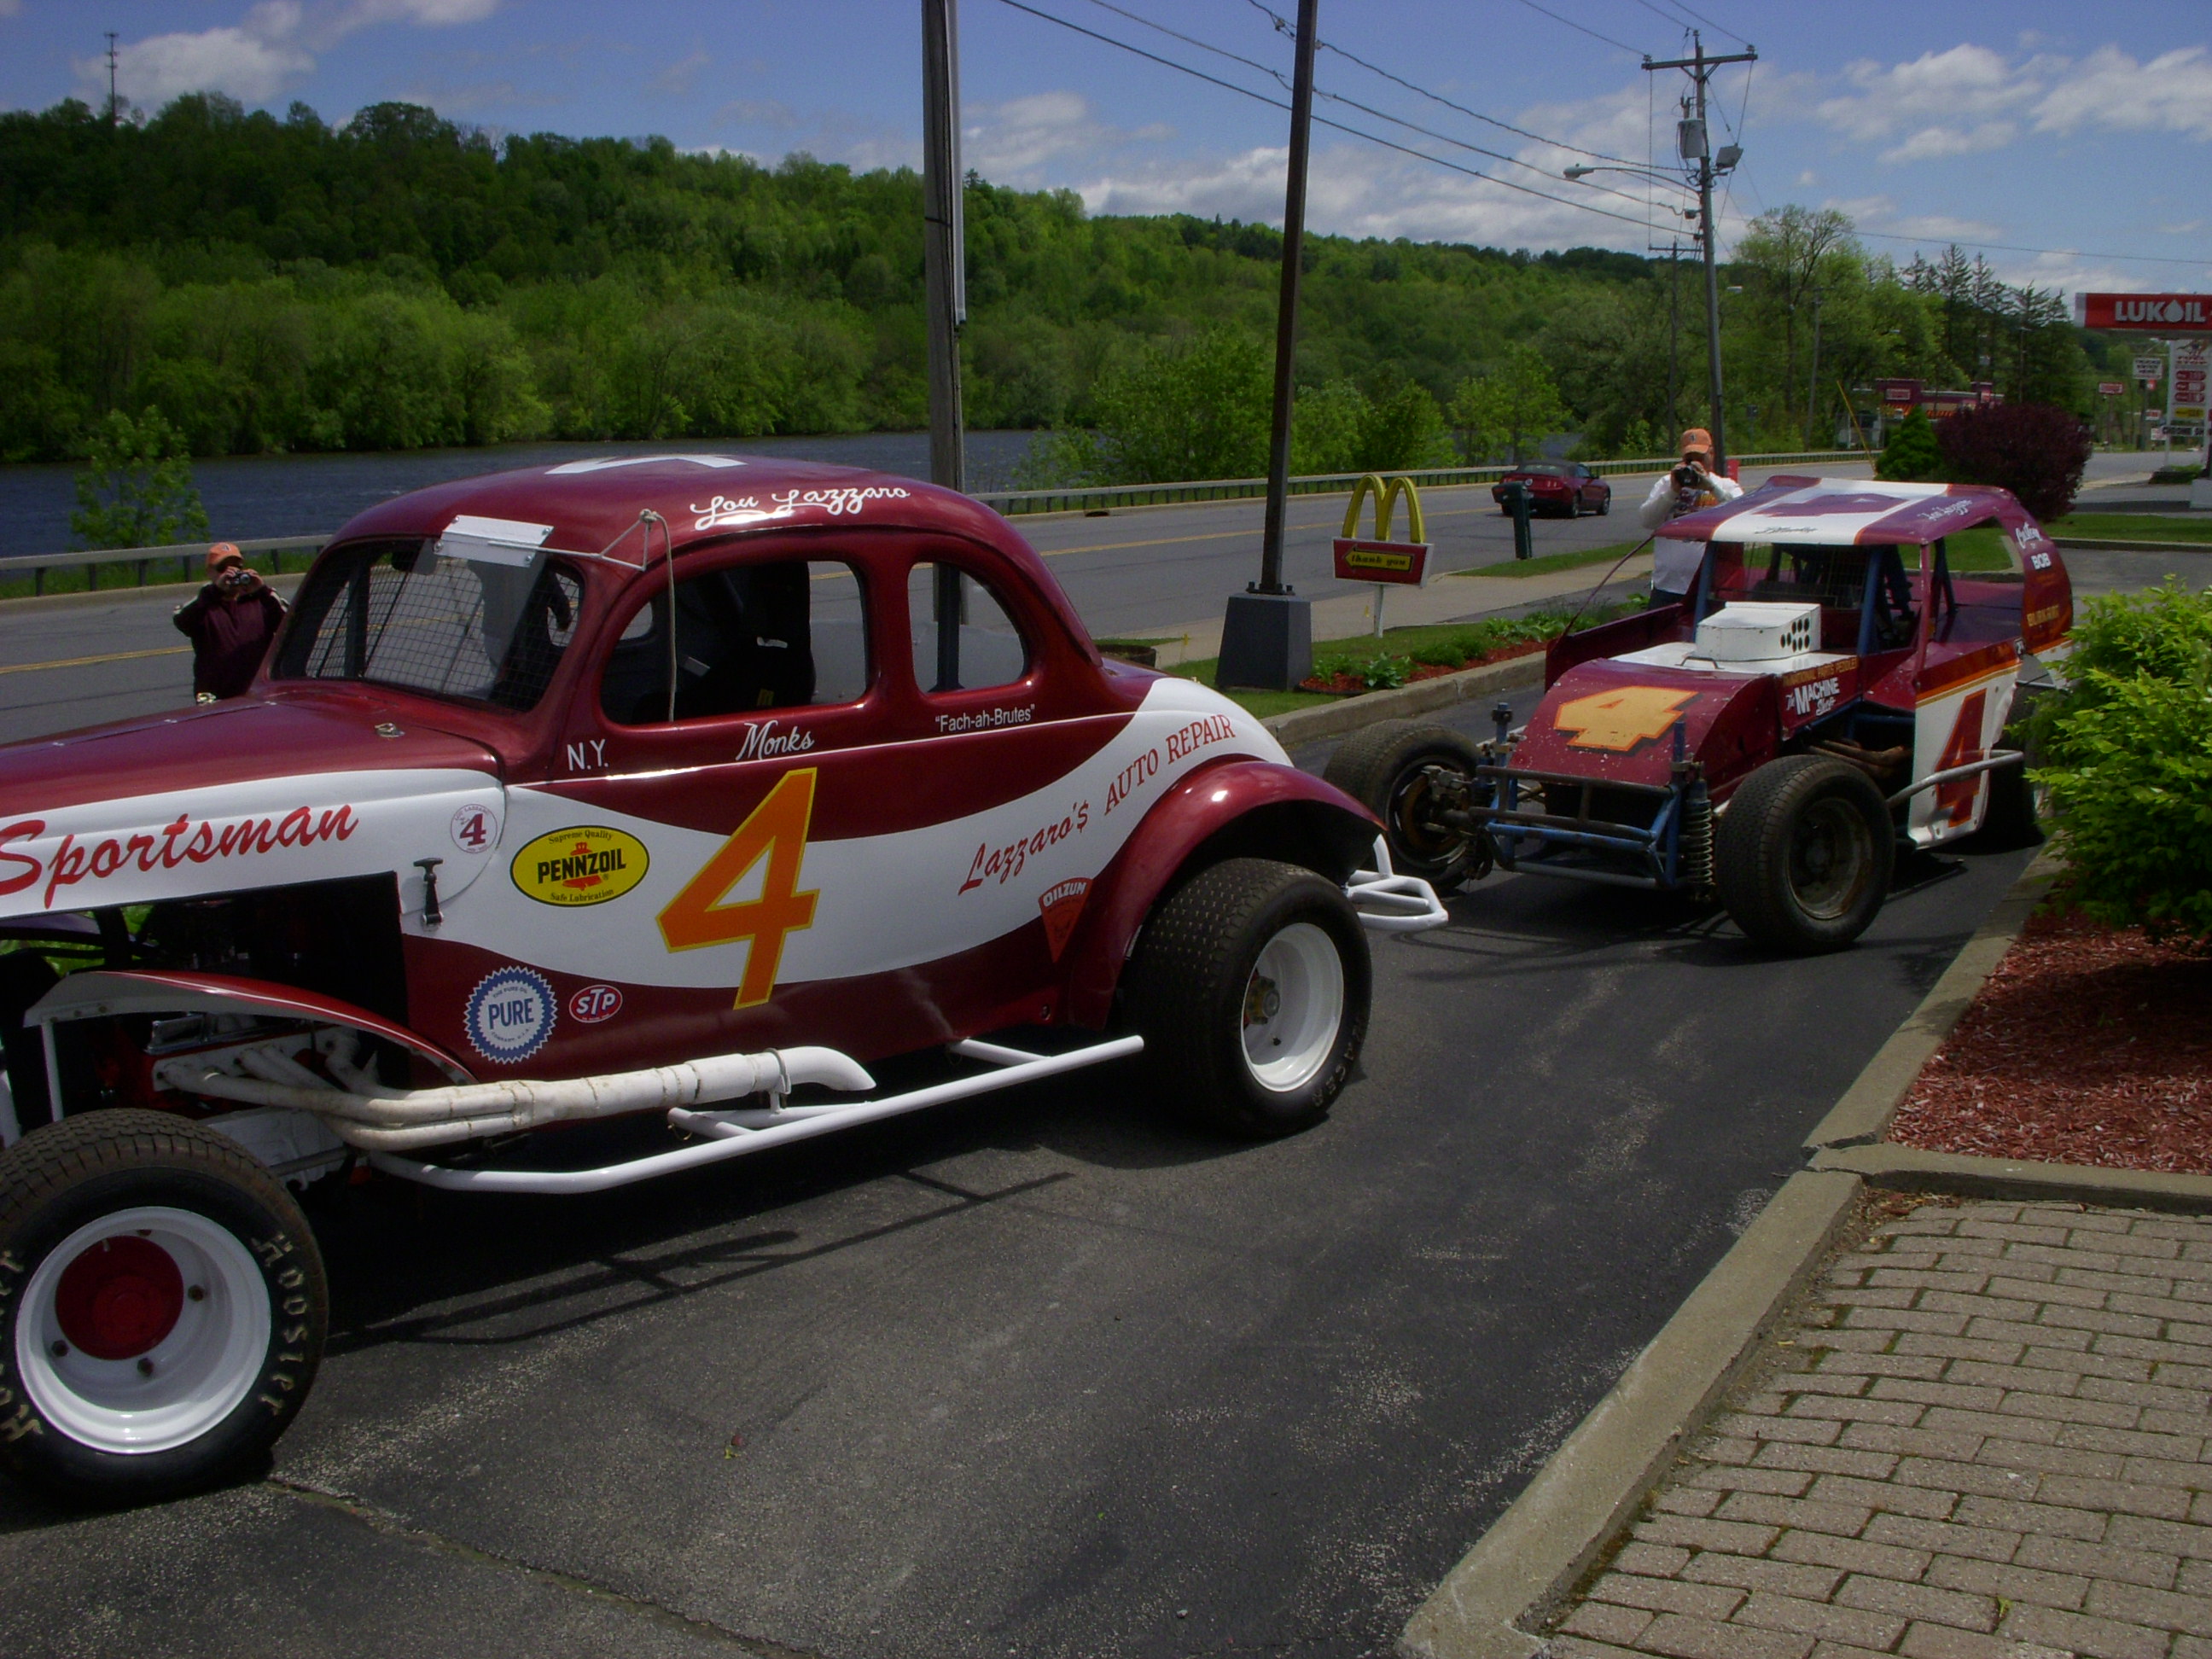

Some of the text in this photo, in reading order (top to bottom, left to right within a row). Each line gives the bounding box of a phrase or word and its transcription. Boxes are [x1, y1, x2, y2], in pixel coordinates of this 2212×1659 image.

[2115, 300, 2207, 323] LUKOIL
[690, 484, 911, 531] Lou Lazzaro
[1351, 554, 1406, 567] thank you
[2031, 552, 2052, 570] BOB
[1794, 676, 1841, 715] MACHINE
[567, 737, 609, 771] N.Y.
[735, 719, 815, 762] Monks
[1103, 748, 1160, 816] AUTO
[1164, 713, 1237, 765] REPAIR
[1935, 688, 1986, 828] 4
[459, 813, 486, 847] 4
[548, 829, 614, 845] Supreme Quality
[0, 804, 359, 910] Sportsman
[537, 847, 627, 885] PENNZOIL
[550, 888, 614, 903] Safe Lubrication
[655, 766, 820, 1010] 4
[1043, 882, 1087, 908] OILZUM
[488, 998, 534, 1030] PURE
[575, 987, 617, 1016] STP
